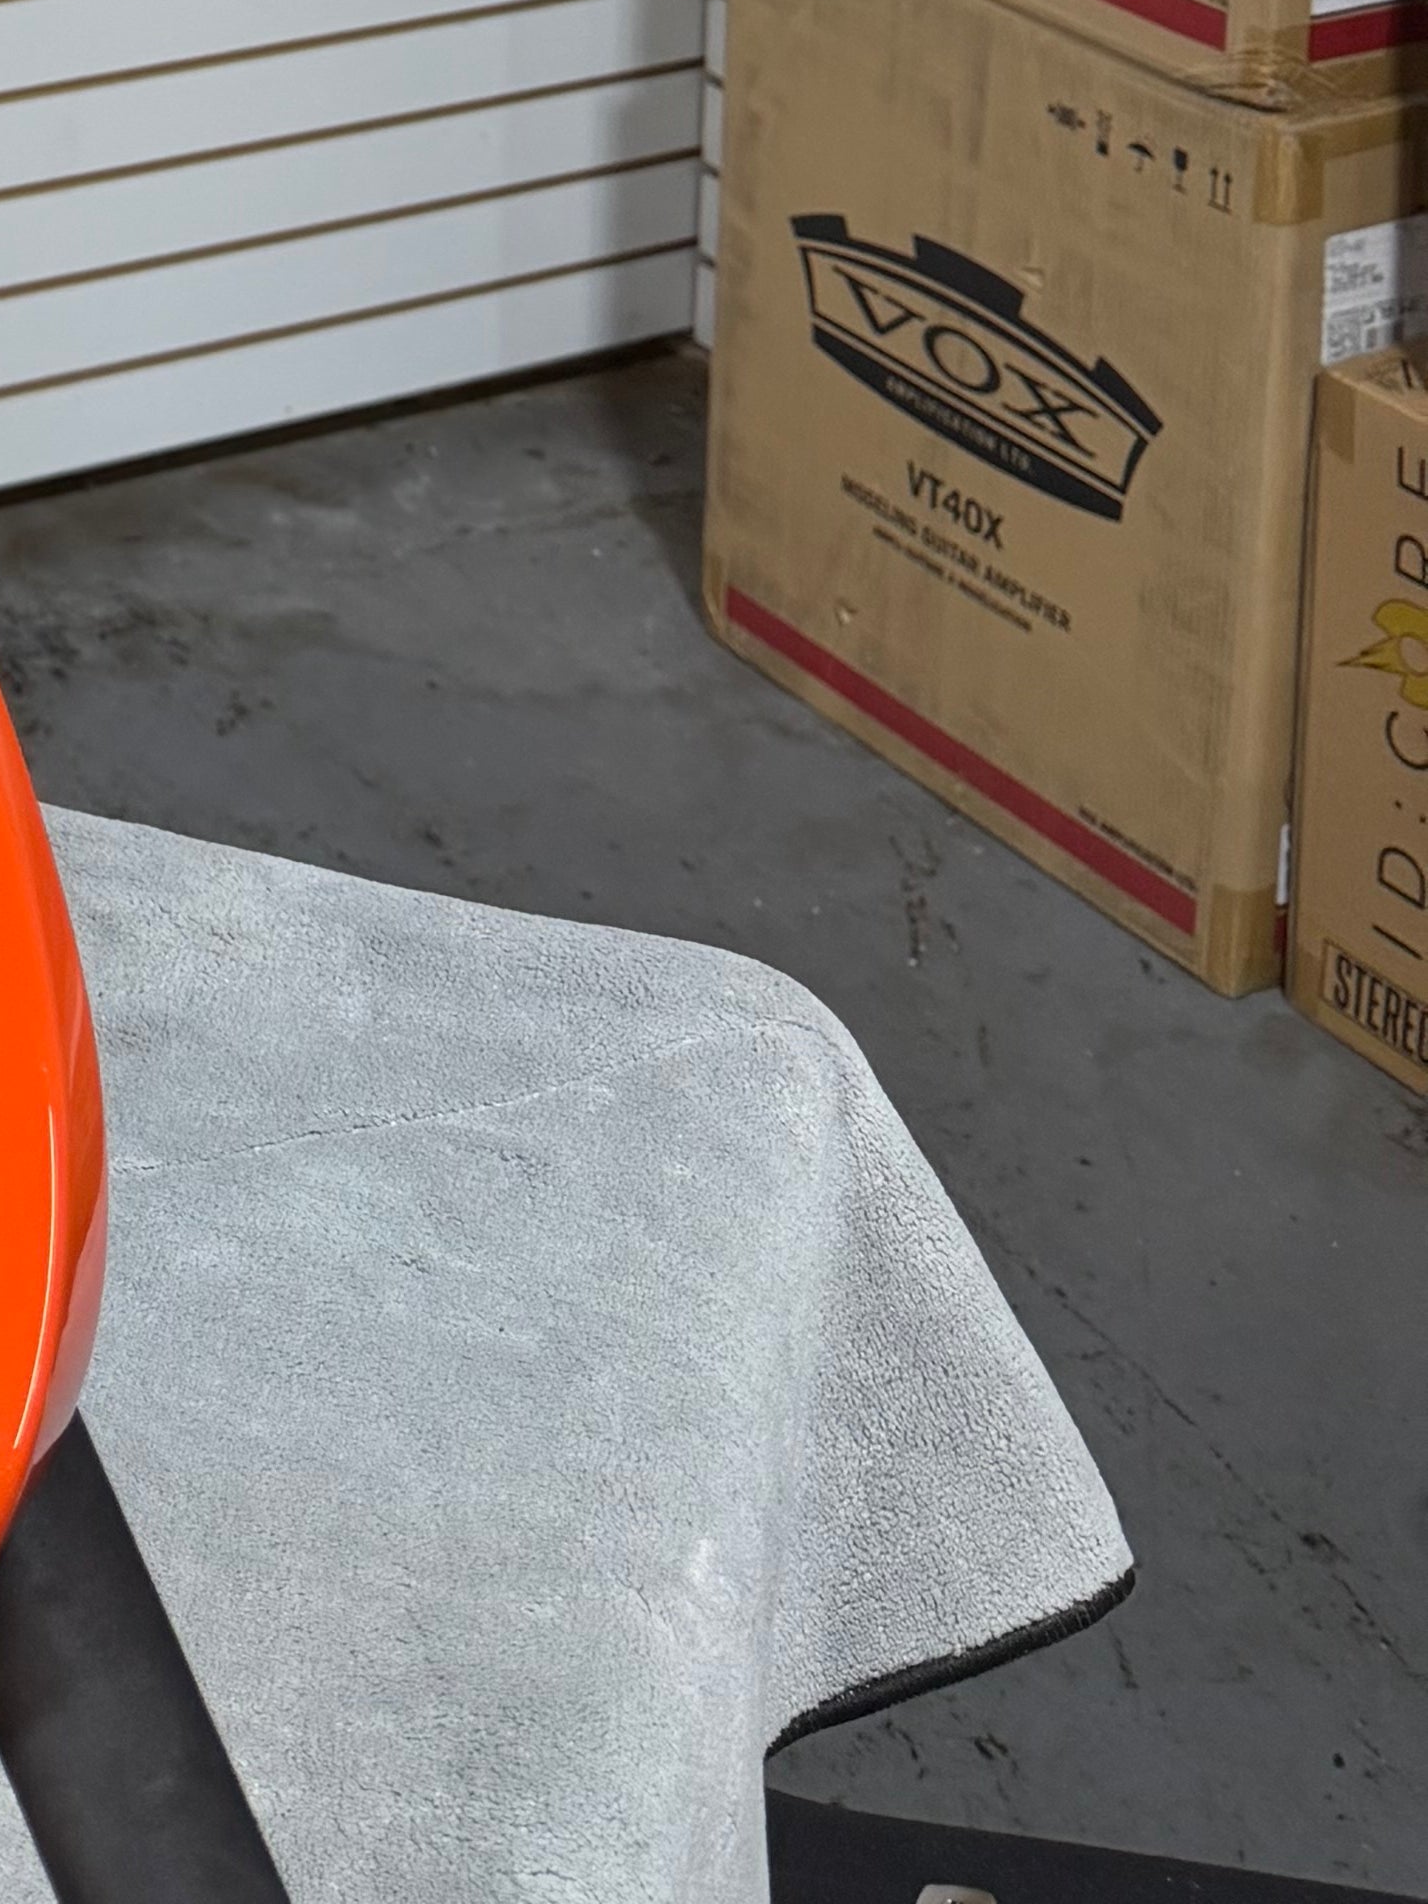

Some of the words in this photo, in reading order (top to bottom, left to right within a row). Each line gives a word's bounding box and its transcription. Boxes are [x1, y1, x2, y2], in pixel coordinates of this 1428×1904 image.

[832, 266, 1100, 459] VOX
[906, 459, 1006, 552] VT40X
[921, 526, 980, 575] GUITAR
[983, 563, 1073, 634] AMPLIFIER
